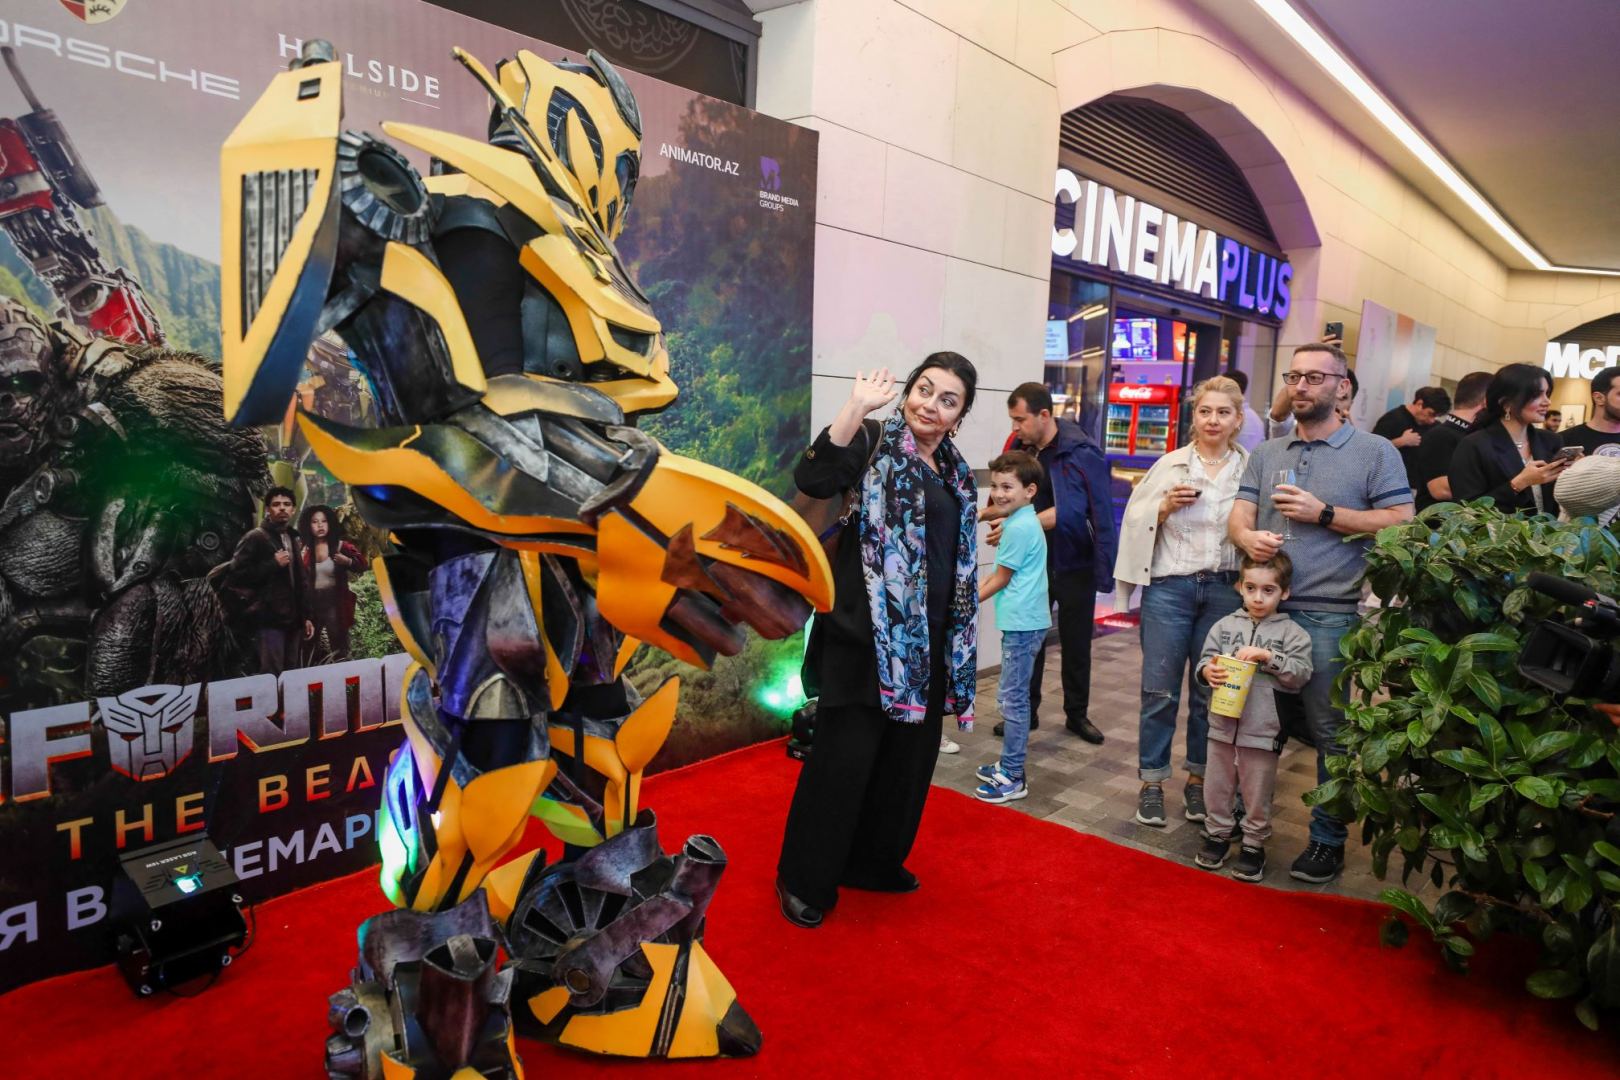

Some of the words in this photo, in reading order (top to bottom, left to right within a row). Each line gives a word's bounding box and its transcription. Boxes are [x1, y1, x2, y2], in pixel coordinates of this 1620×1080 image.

[0, 19, 240, 100] RSCHE
[278, 33, 440, 99] HLSIDE
[659, 143, 740, 176] ANIMATOR.AZ
[759, 190, 781, 203] BRAND
[781, 195, 799, 207] MEDIA
[759, 200, 785, 212] GROUPS
[1051, 168, 1294, 320] CINEMAPLUS
[56, 792, 205, 860] THE
[258, 748, 399, 815] BEA
[219, 809, 380, 881] EMAP
